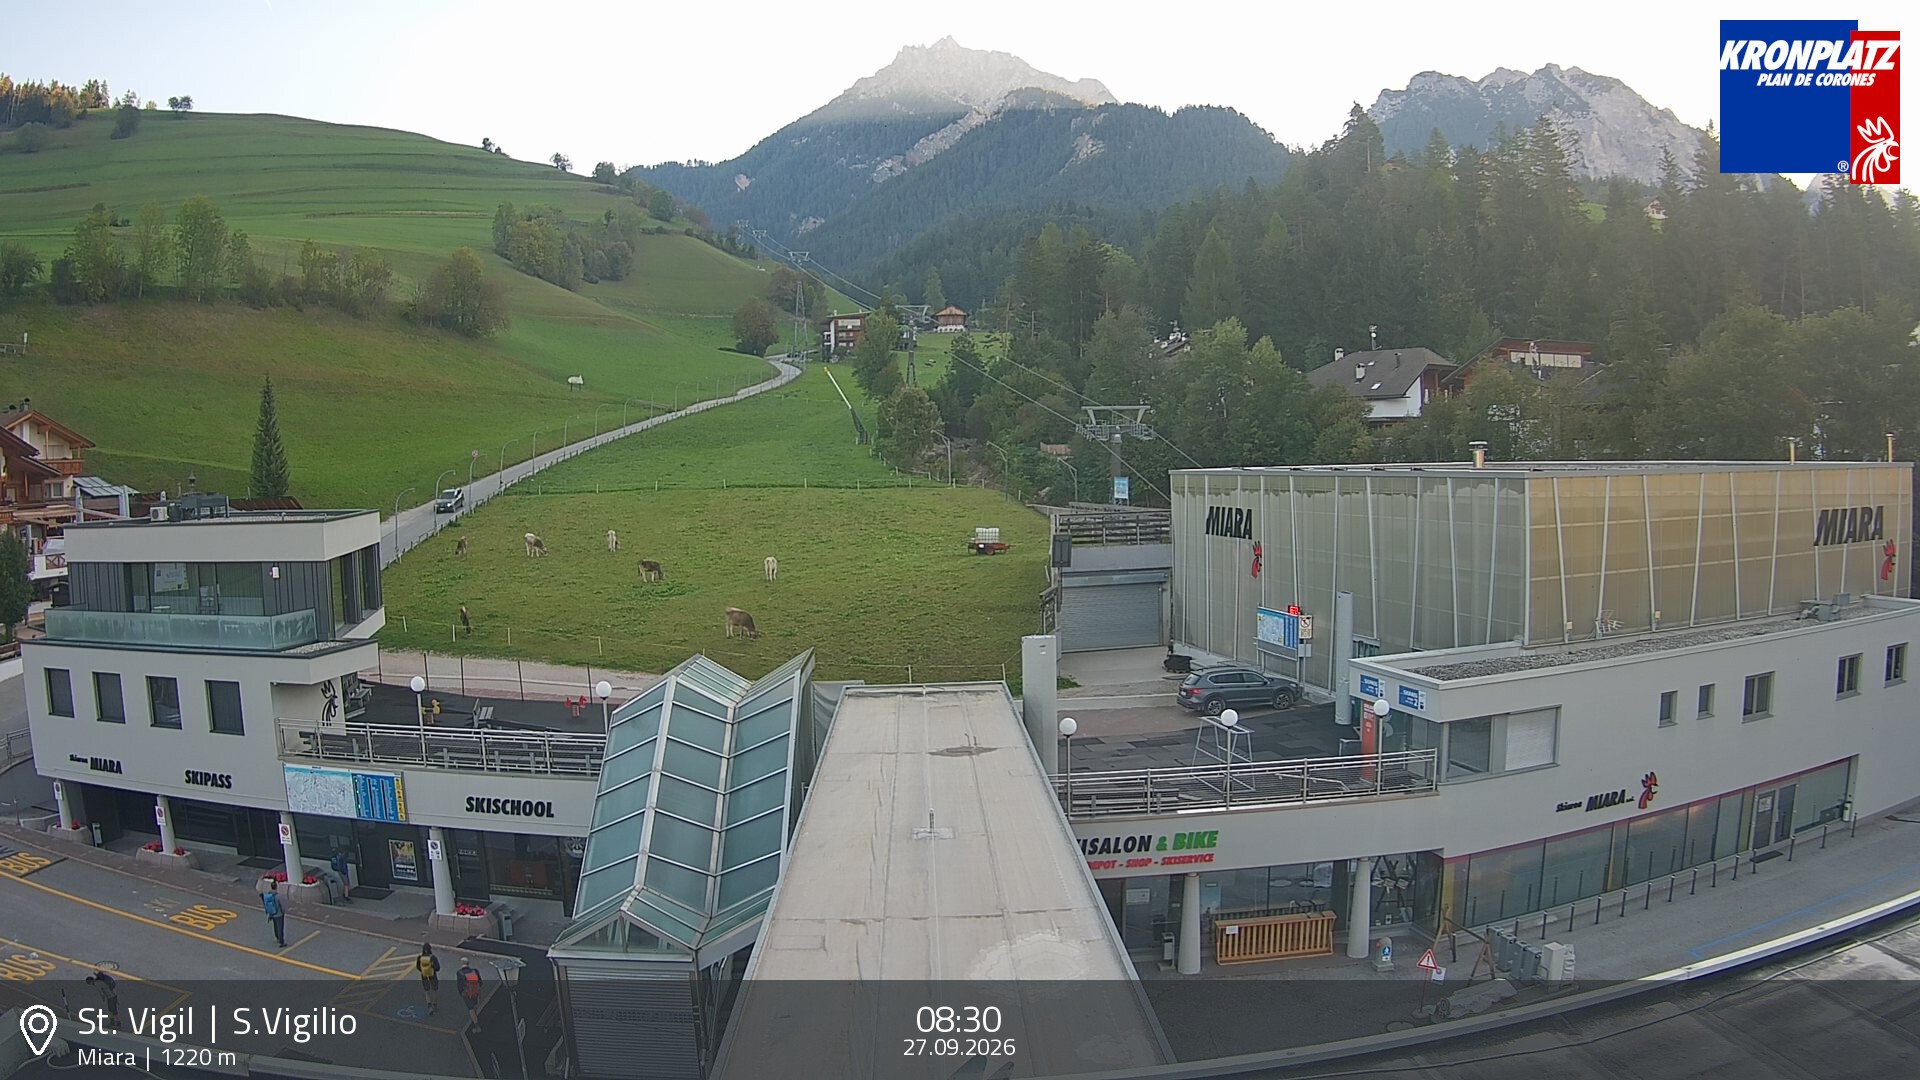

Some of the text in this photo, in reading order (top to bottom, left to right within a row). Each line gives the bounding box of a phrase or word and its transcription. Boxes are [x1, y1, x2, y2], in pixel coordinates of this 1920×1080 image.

[1205, 506, 1252, 540] MIARA
[1813, 505, 1884, 546] MIARA
[90, 757, 123, 774] MIARA
[185, 770, 232, 789] SKIPASS
[465, 796, 555, 818] SKISCHOOL
[1585, 789, 1626, 812] MIARA
[1077, 830, 1218, 855] ISALON & BIKE
[1125, 858, 1153, 868] SHOP
[169, 904, 238, 931] BUS
